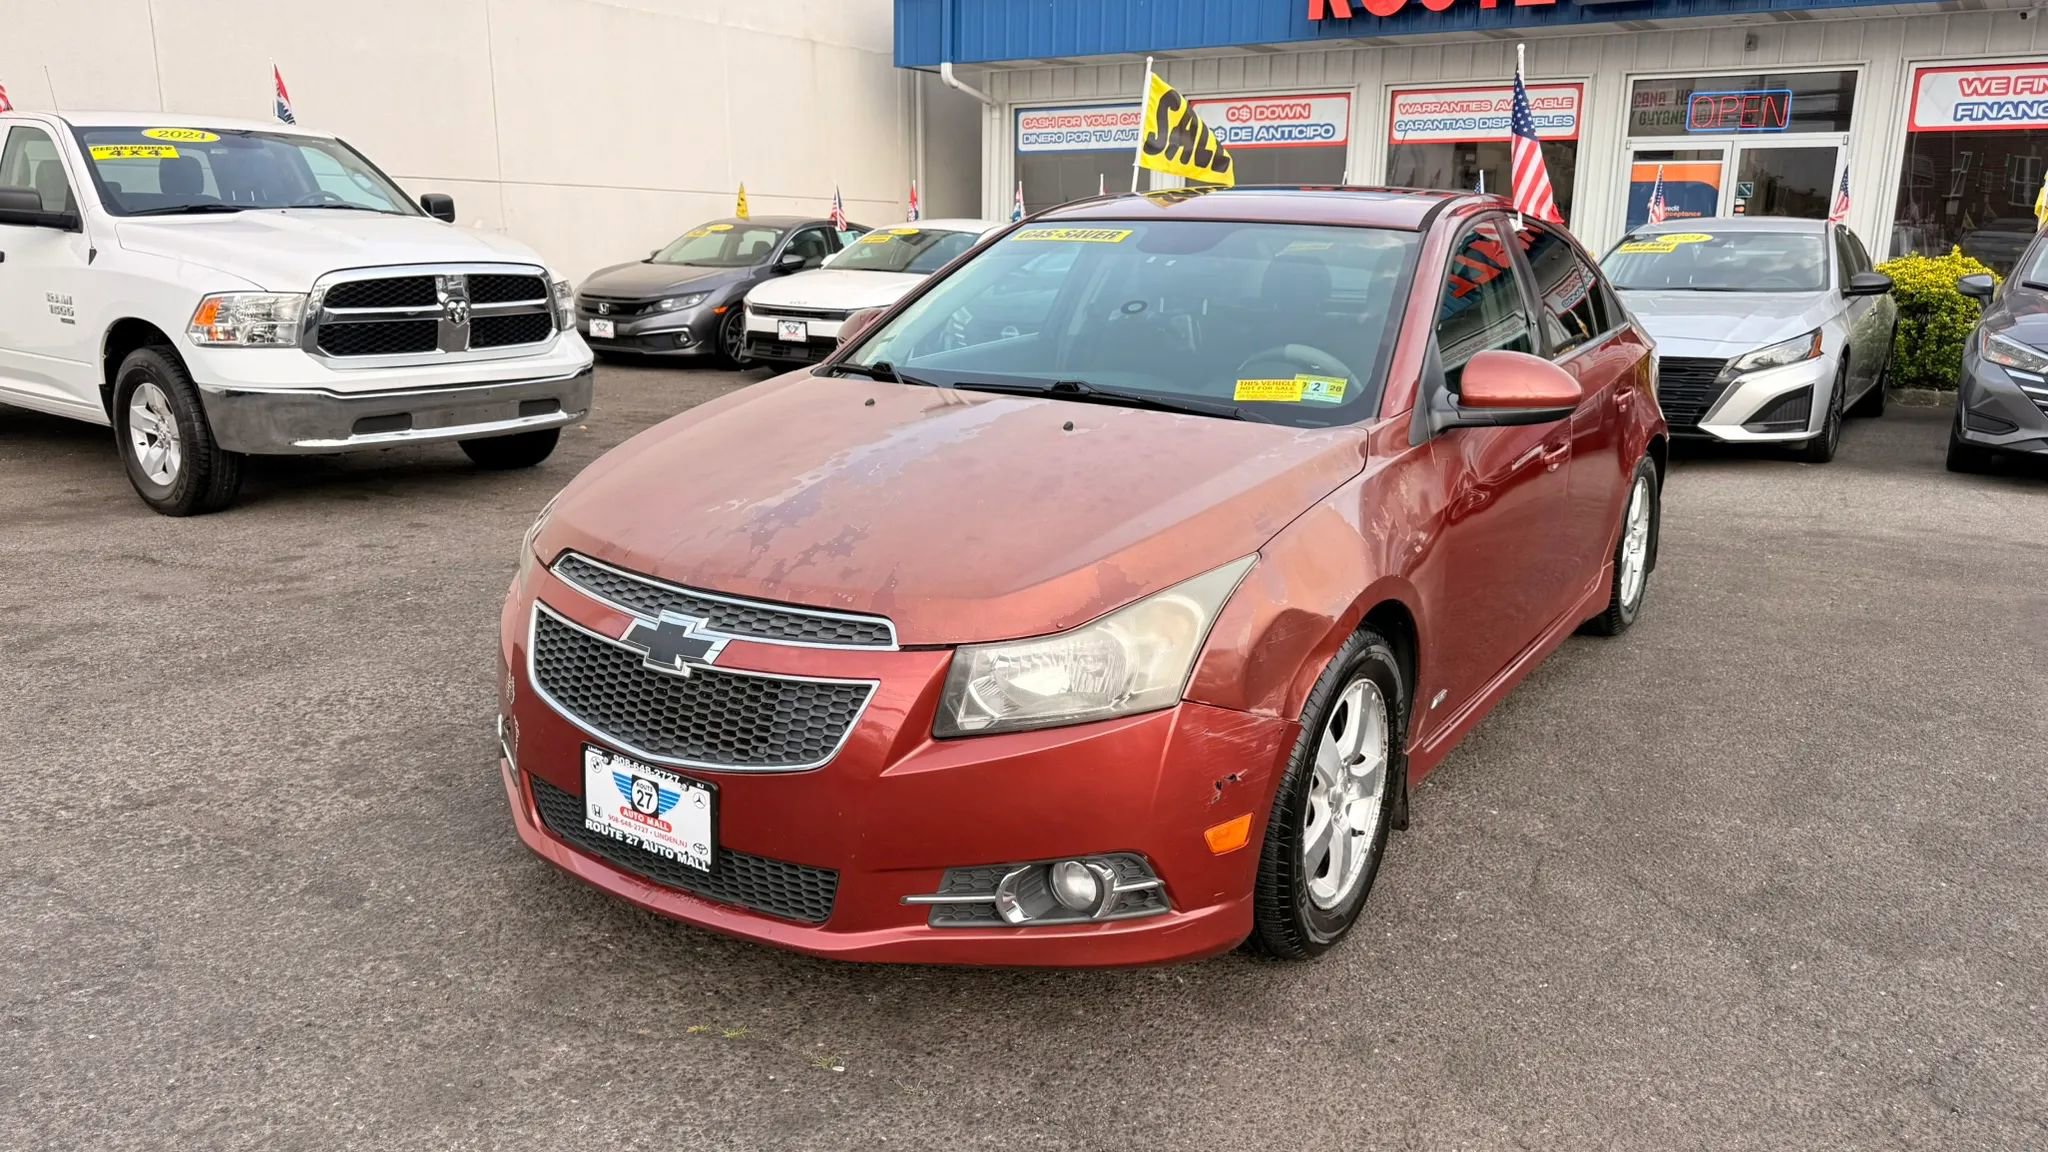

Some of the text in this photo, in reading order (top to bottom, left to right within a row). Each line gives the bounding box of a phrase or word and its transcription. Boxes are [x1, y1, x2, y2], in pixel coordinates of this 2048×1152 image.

[1958, 76, 2011, 97] WE
[1254, 103, 1311, 120] DOWN
[1399, 97, 1574, 115] WARRANTIES AVABLE
[1691, 95, 1789, 128] OPEN
[1023, 117, 1056, 129] CASH
[1057, 116, 1082, 128] FOR
[1083, 114, 1118, 126] YOUR
[1395, 115, 1575, 132] GARANTIAS DISPBLES
[157, 130, 207, 140] 2024
[1023, 129, 1141, 144] DINERO POR TU AUT
[1229, 127, 1253, 141] DE
[1255, 124, 1336, 141] ANTICIPO
[637, 789, 653, 810] 27
[622, 808, 670, 832] AUTO MALL
[585, 820, 710, 873] ROUTE 27 AUTO MALL
